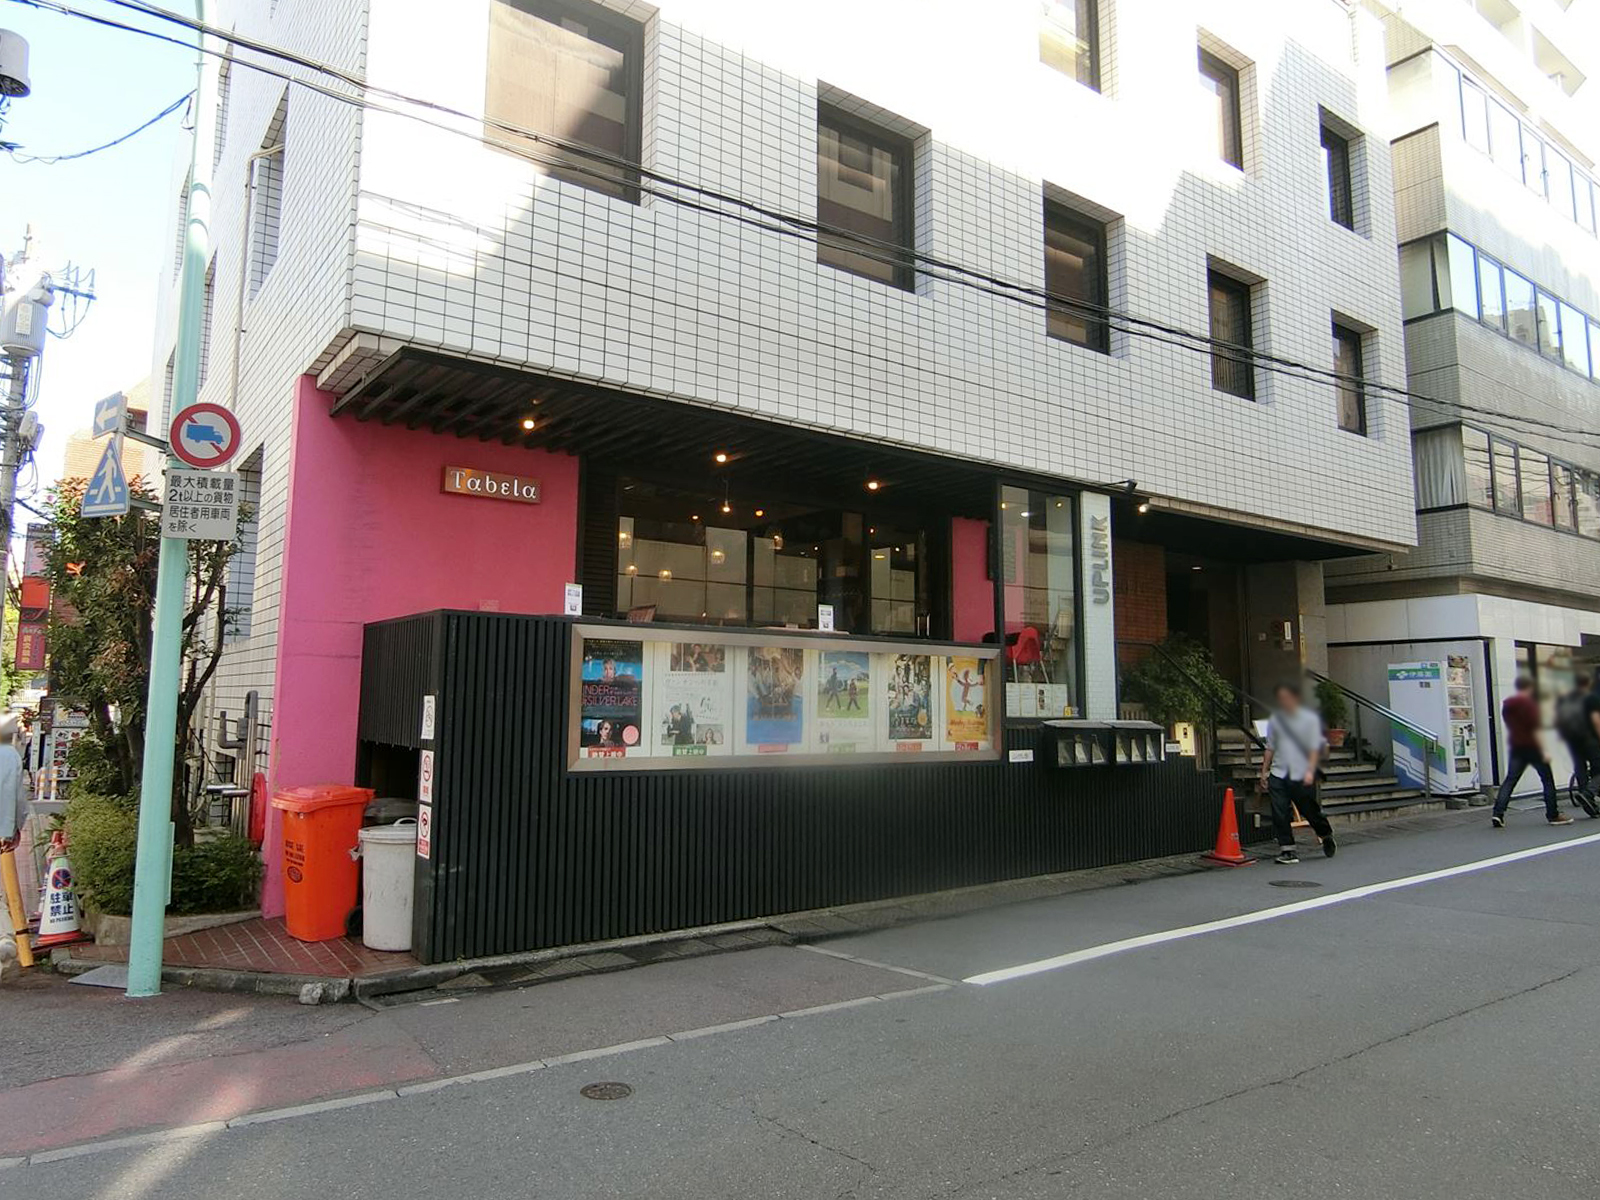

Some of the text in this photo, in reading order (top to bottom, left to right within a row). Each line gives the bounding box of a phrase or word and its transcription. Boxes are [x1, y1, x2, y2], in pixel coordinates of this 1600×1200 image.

[170, 475, 234, 490] 最大積載量
[450, 470, 537, 499] Tabela
[169, 489, 233, 504] 2t以上の貨物
[169, 505, 231, 520] 居住者用車両
[168, 520, 197, 533] を除く
[1091, 514, 1110, 605] UPLINK
[50, 892, 73, 904] 駐車
[50, 904, 74, 916] 禁止
